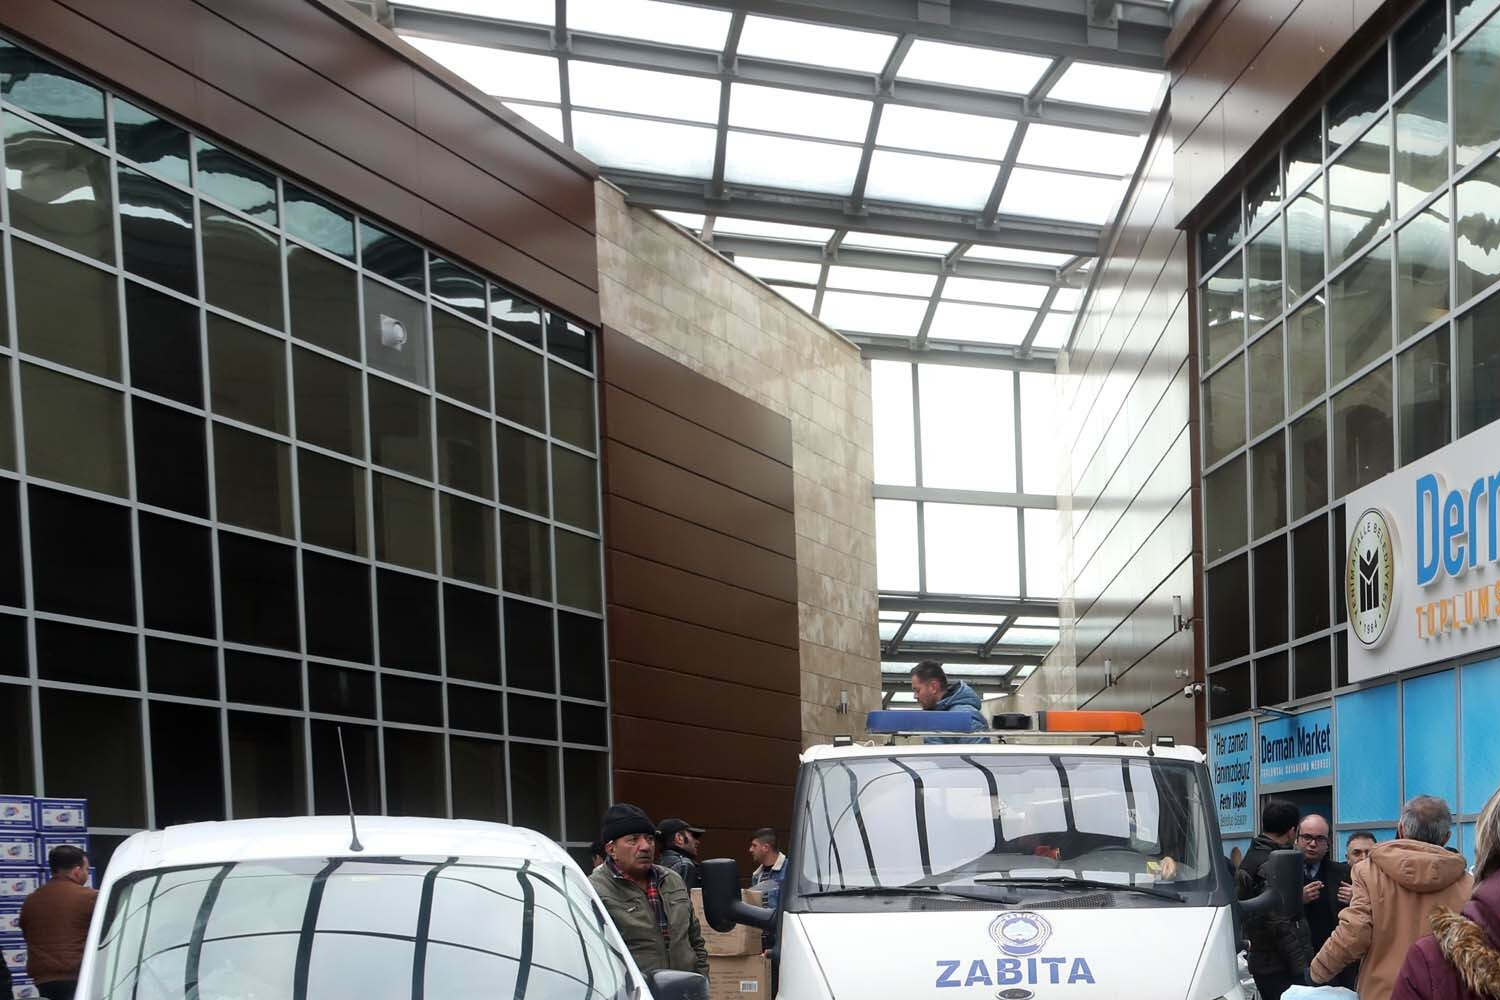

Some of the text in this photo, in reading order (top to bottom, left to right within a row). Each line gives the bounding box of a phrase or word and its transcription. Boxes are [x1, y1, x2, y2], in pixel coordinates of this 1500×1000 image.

[1373, 522, 1390, 610] BELEDİYESİ
[1363, 619, 1378, 634] 1984
[1228, 732, 1248, 754] zaman
[1261, 723, 1331, 764] Derman Market
[1220, 793, 1231, 811] Fethi
[935, 957, 1096, 988] ZABITA
